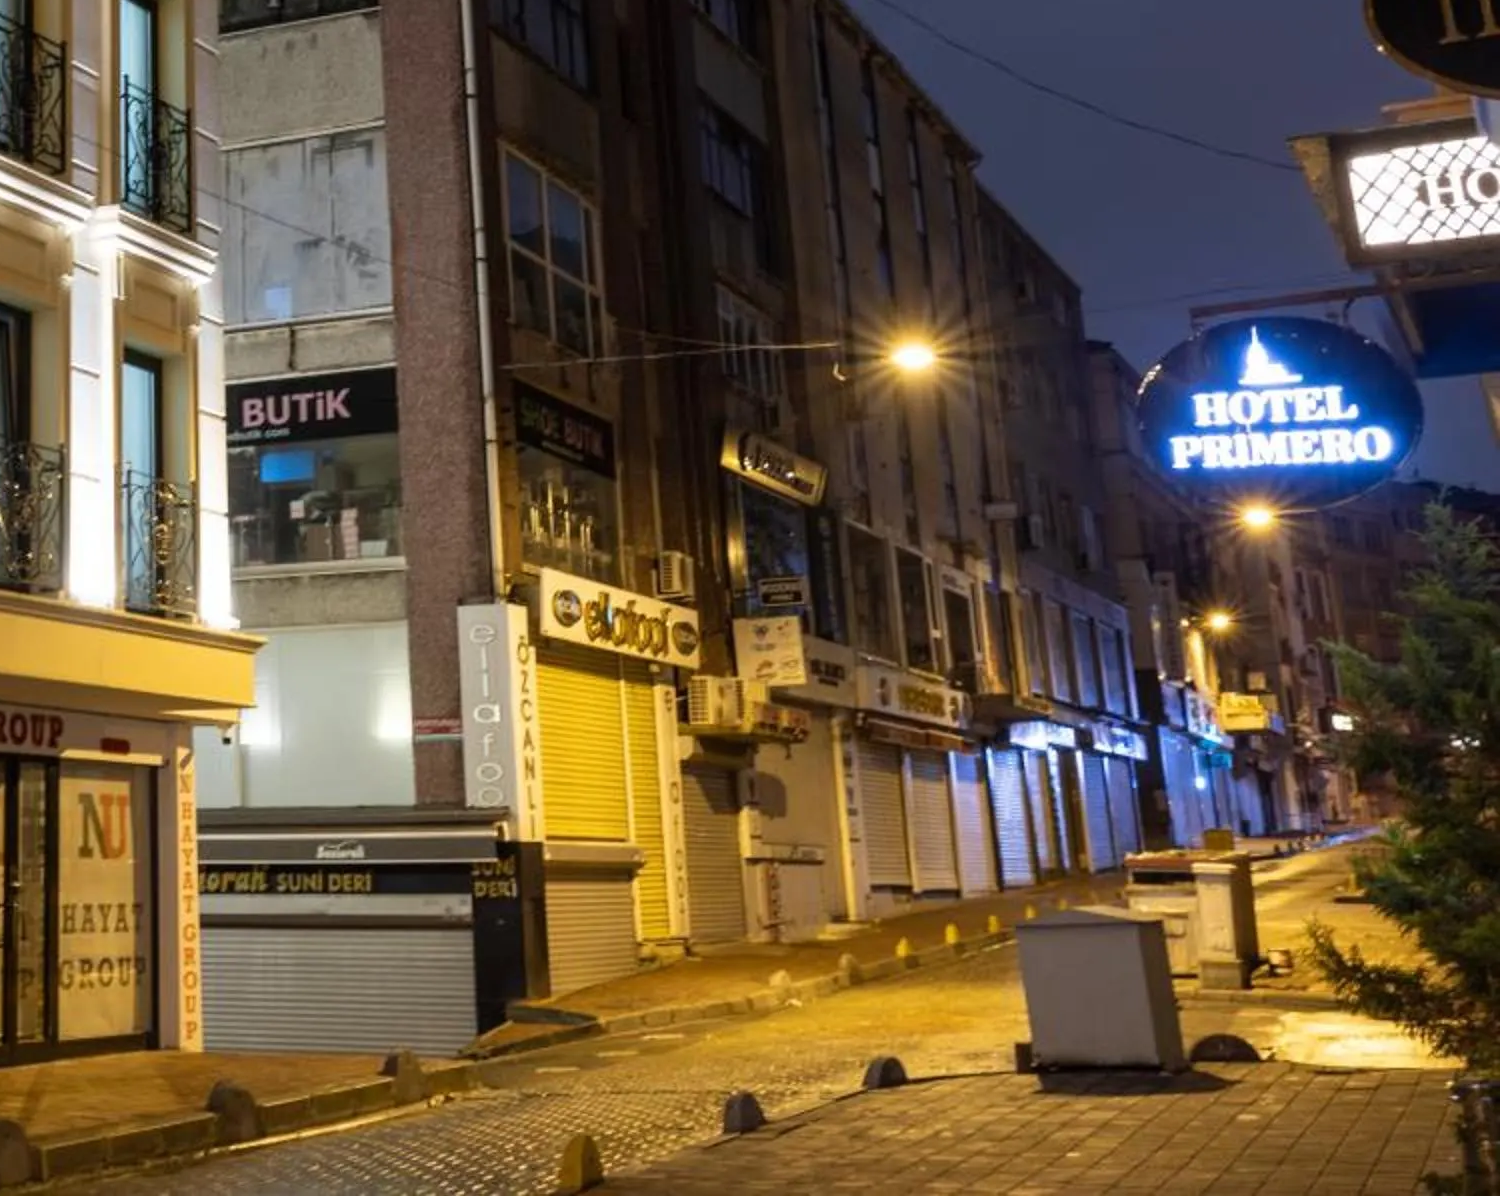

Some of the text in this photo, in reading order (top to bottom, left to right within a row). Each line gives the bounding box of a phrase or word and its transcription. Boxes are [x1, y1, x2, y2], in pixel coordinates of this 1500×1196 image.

[1192, 384, 1360, 426] HOTEL
[77, 791, 130, 860] NU
[61, 902, 145, 935] HAYAT
[58, 954, 147, 991] GROUP
[181, 922, 199, 1041] GROUP
